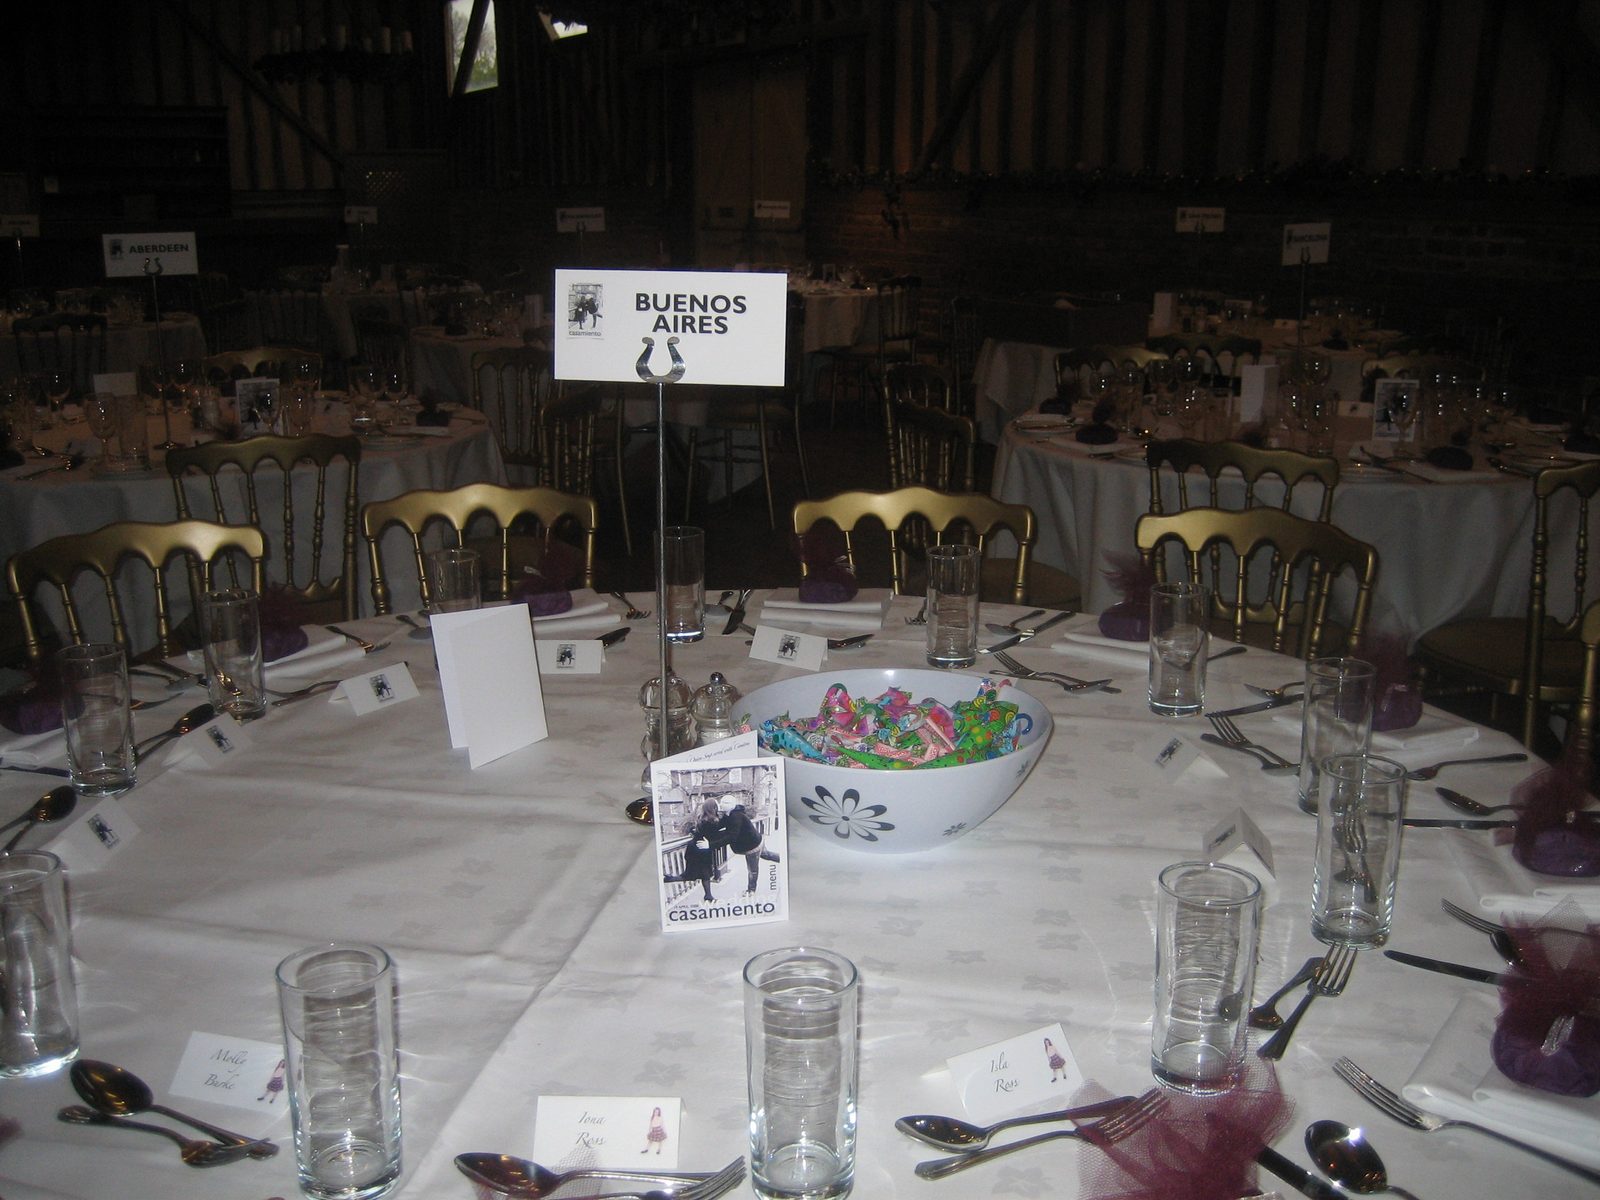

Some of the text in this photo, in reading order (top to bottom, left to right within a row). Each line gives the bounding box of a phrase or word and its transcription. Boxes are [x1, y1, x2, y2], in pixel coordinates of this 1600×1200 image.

[129, 243, 189, 254] ABERDEEN
[635, 293, 747, 314] BUENOS
[652, 315, 729, 334] AIRES
[769, 865, 777, 891] menu
[669, 902, 775, 921] casamiento
[995, 1078, 1021, 1093] Ross
[578, 1111, 606, 1125] Iona
[575, 1131, 606, 1148] Ross
